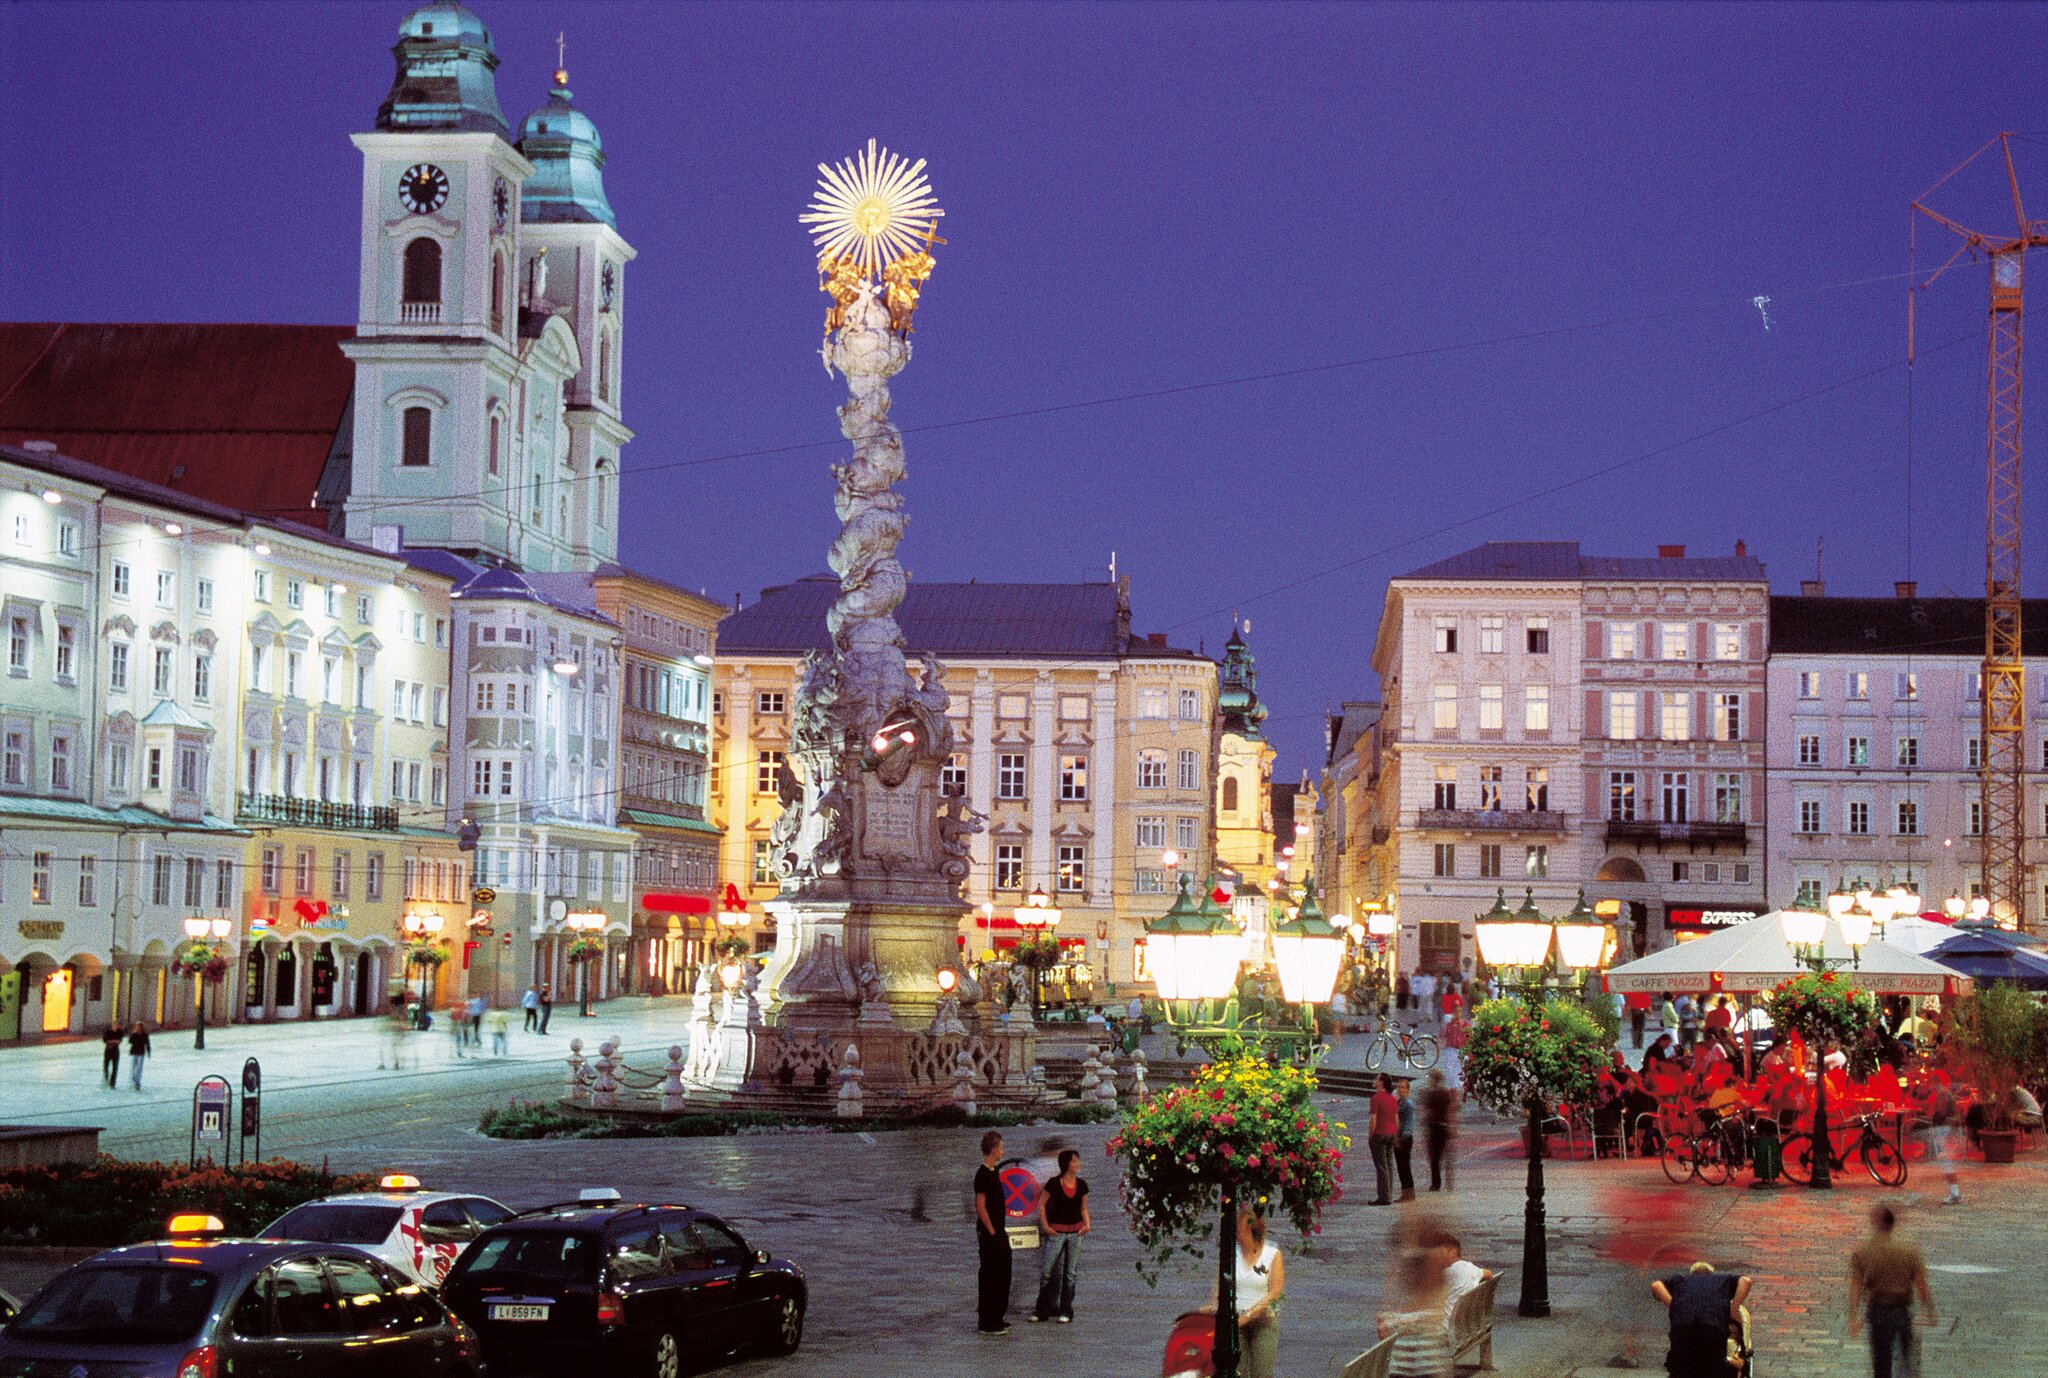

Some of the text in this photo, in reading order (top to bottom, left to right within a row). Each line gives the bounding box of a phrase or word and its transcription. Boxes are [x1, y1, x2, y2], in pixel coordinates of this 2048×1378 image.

[1631, 979, 1704, 989] CAFFE PIAZZA
[1863, 979, 1938, 989] CAFFE PIAZZA
[1011, 1238, 1023, 1246] Taxi
